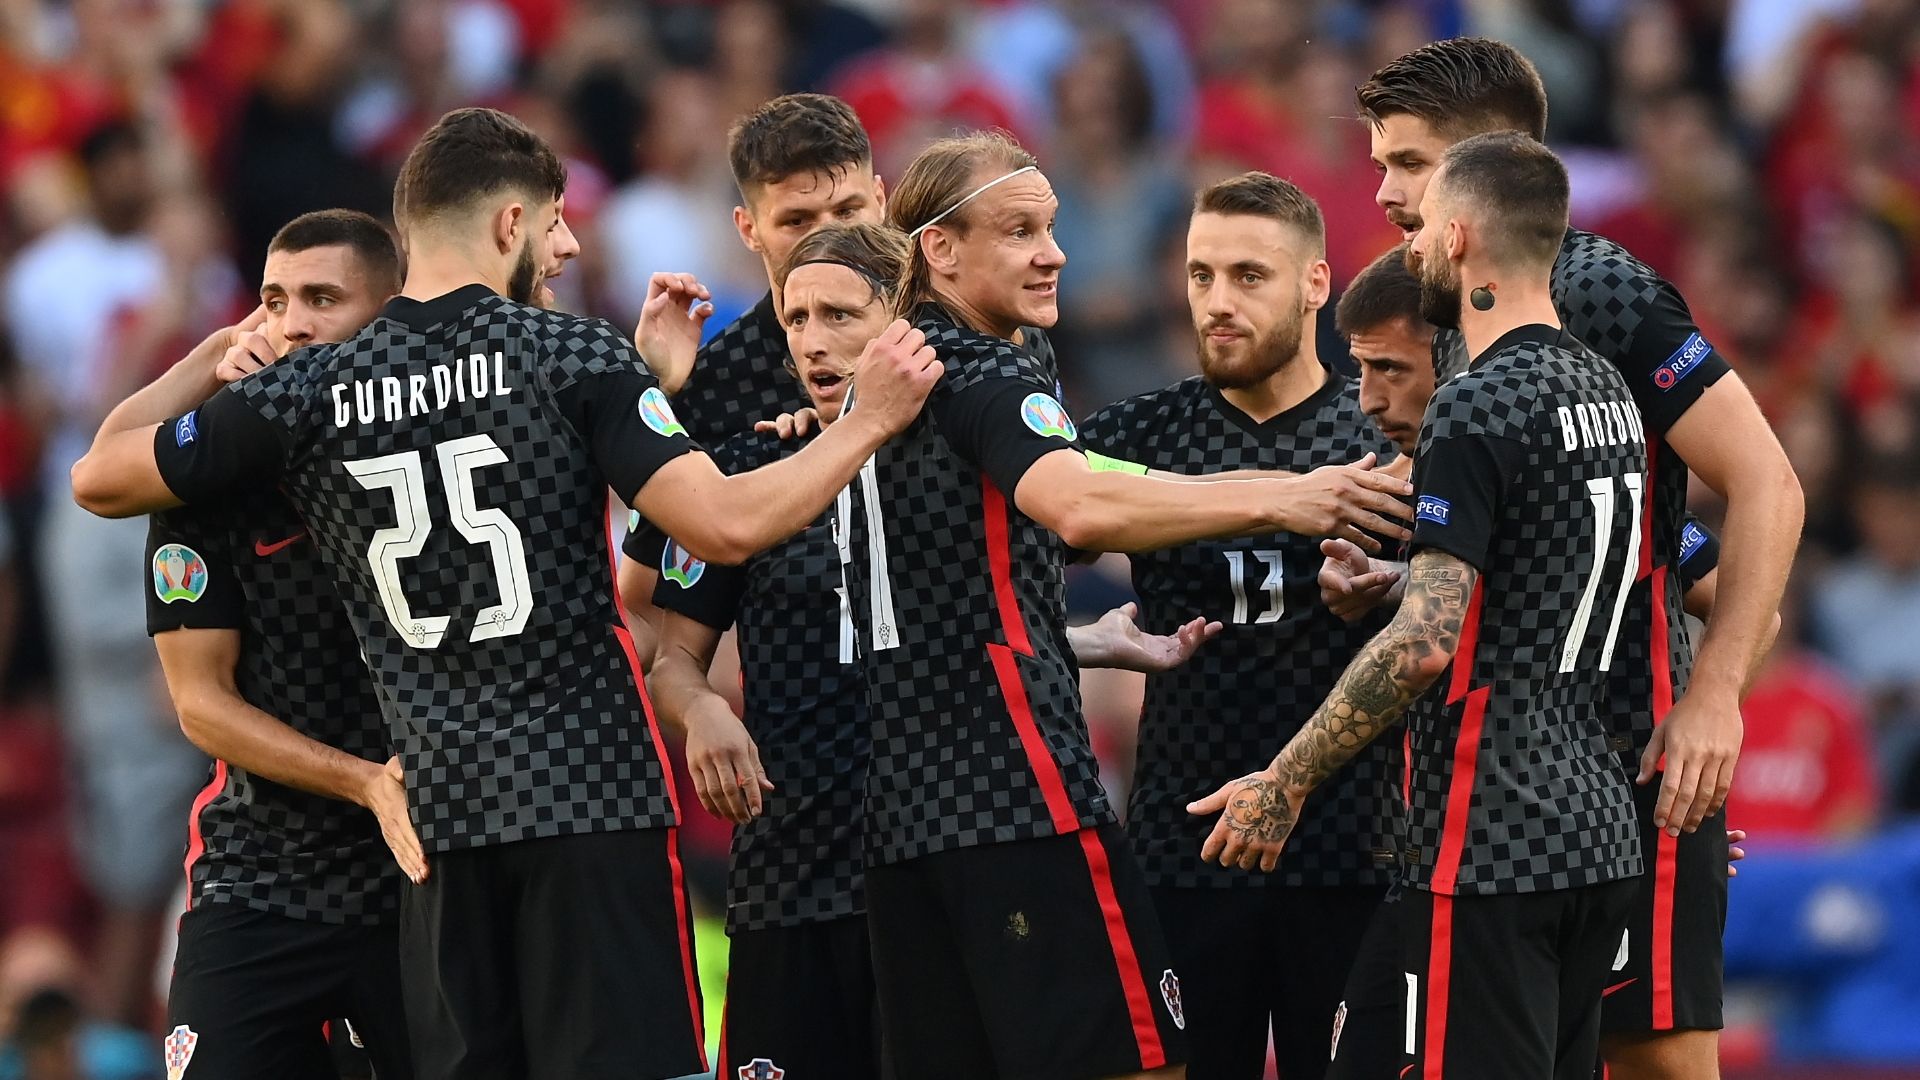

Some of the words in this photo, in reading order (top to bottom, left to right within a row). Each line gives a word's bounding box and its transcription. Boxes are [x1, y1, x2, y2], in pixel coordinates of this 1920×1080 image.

[331, 352, 512, 428] GUARDIOL
[1671, 336, 1706, 374] RESPECT
[342, 433, 534, 649] 25
[1558, 473, 1643, 674] 11
[1222, 549, 1285, 625] 13
